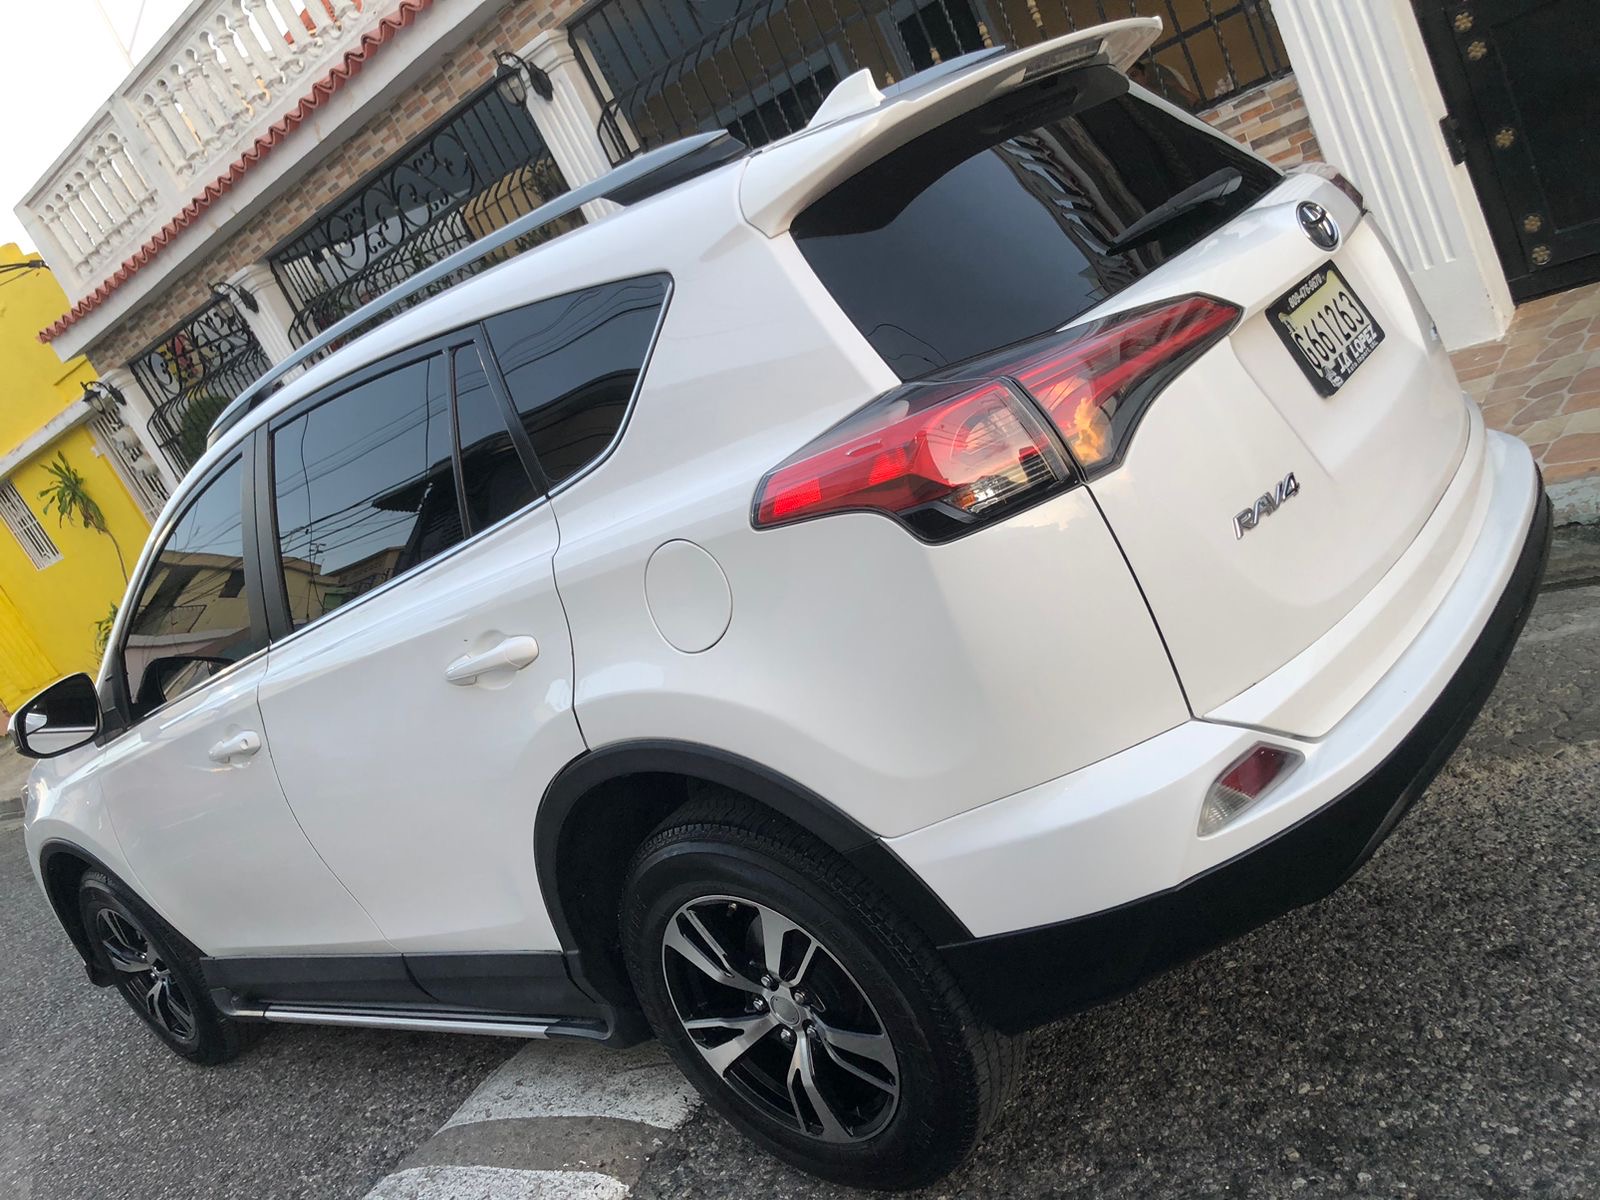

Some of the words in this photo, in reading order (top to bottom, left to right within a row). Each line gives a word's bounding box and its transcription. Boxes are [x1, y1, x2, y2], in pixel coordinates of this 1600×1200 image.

[1294, 291, 1365, 370] G661263
[1349, 323, 1378, 359] LOPEZ
[1232, 471, 1300, 541] RAV4
